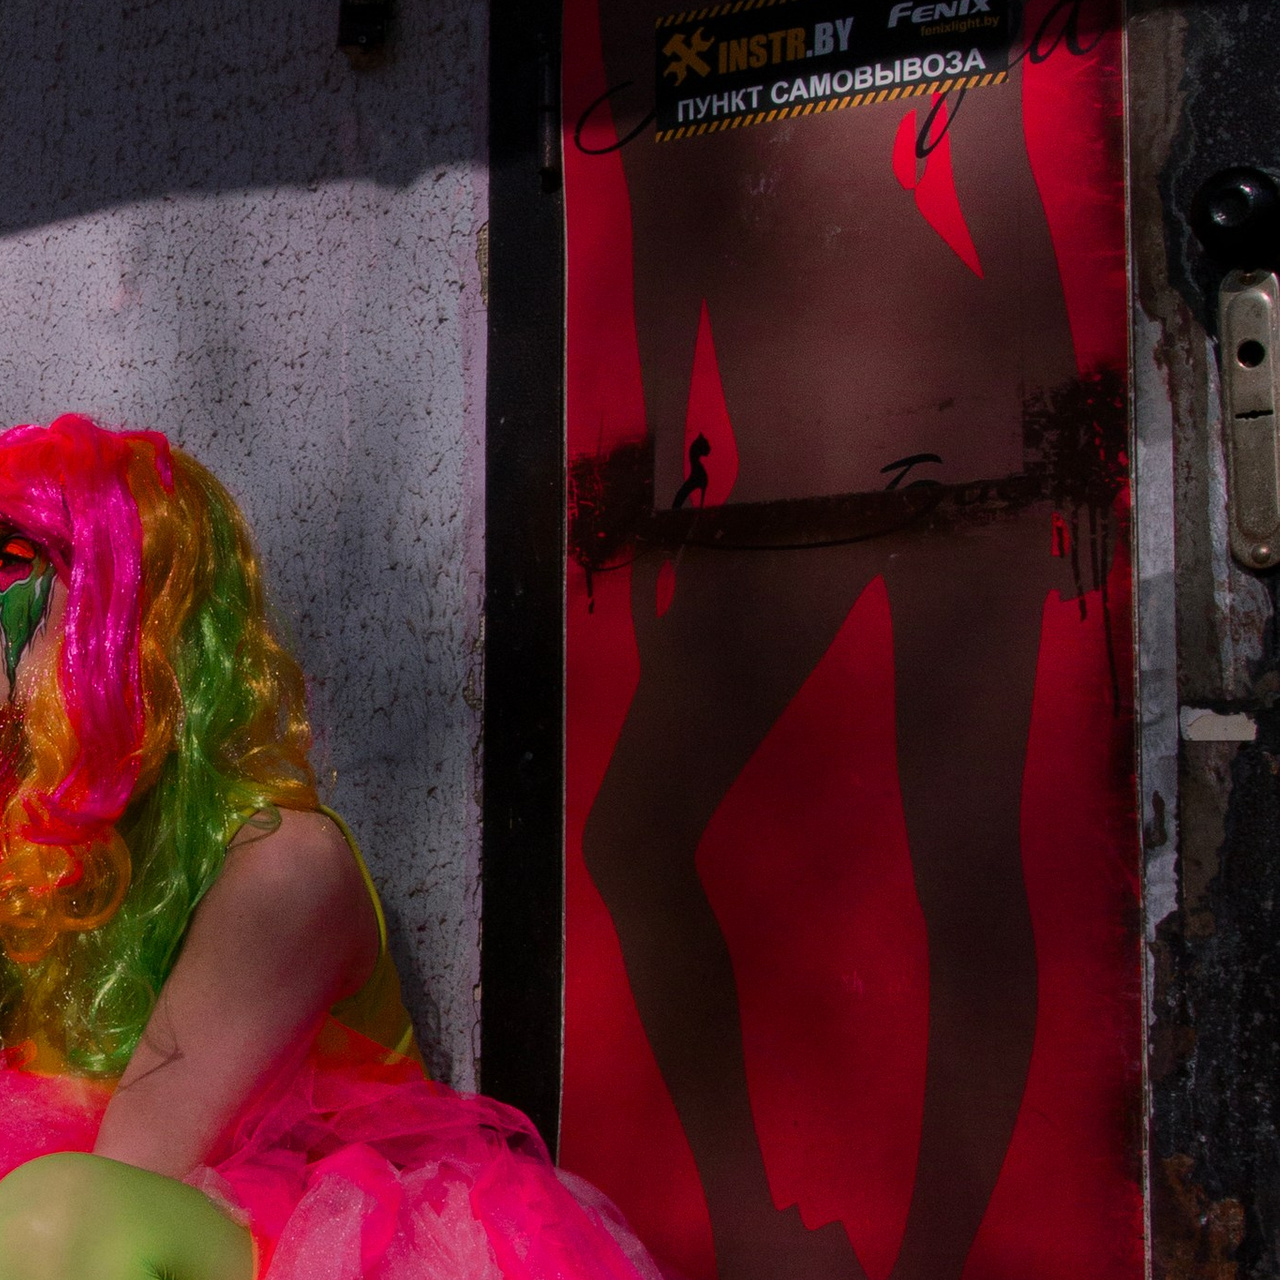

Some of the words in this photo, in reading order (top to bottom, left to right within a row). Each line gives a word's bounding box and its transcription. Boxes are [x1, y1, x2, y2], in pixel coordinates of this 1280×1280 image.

[717, 16, 855, 76] INSTR.BY
[920, 14, 1001, 38] fenixlight.by
[676, 83, 765, 123] ПУНКТ
[770, 46, 987, 106] САМОВЫВОЗА
